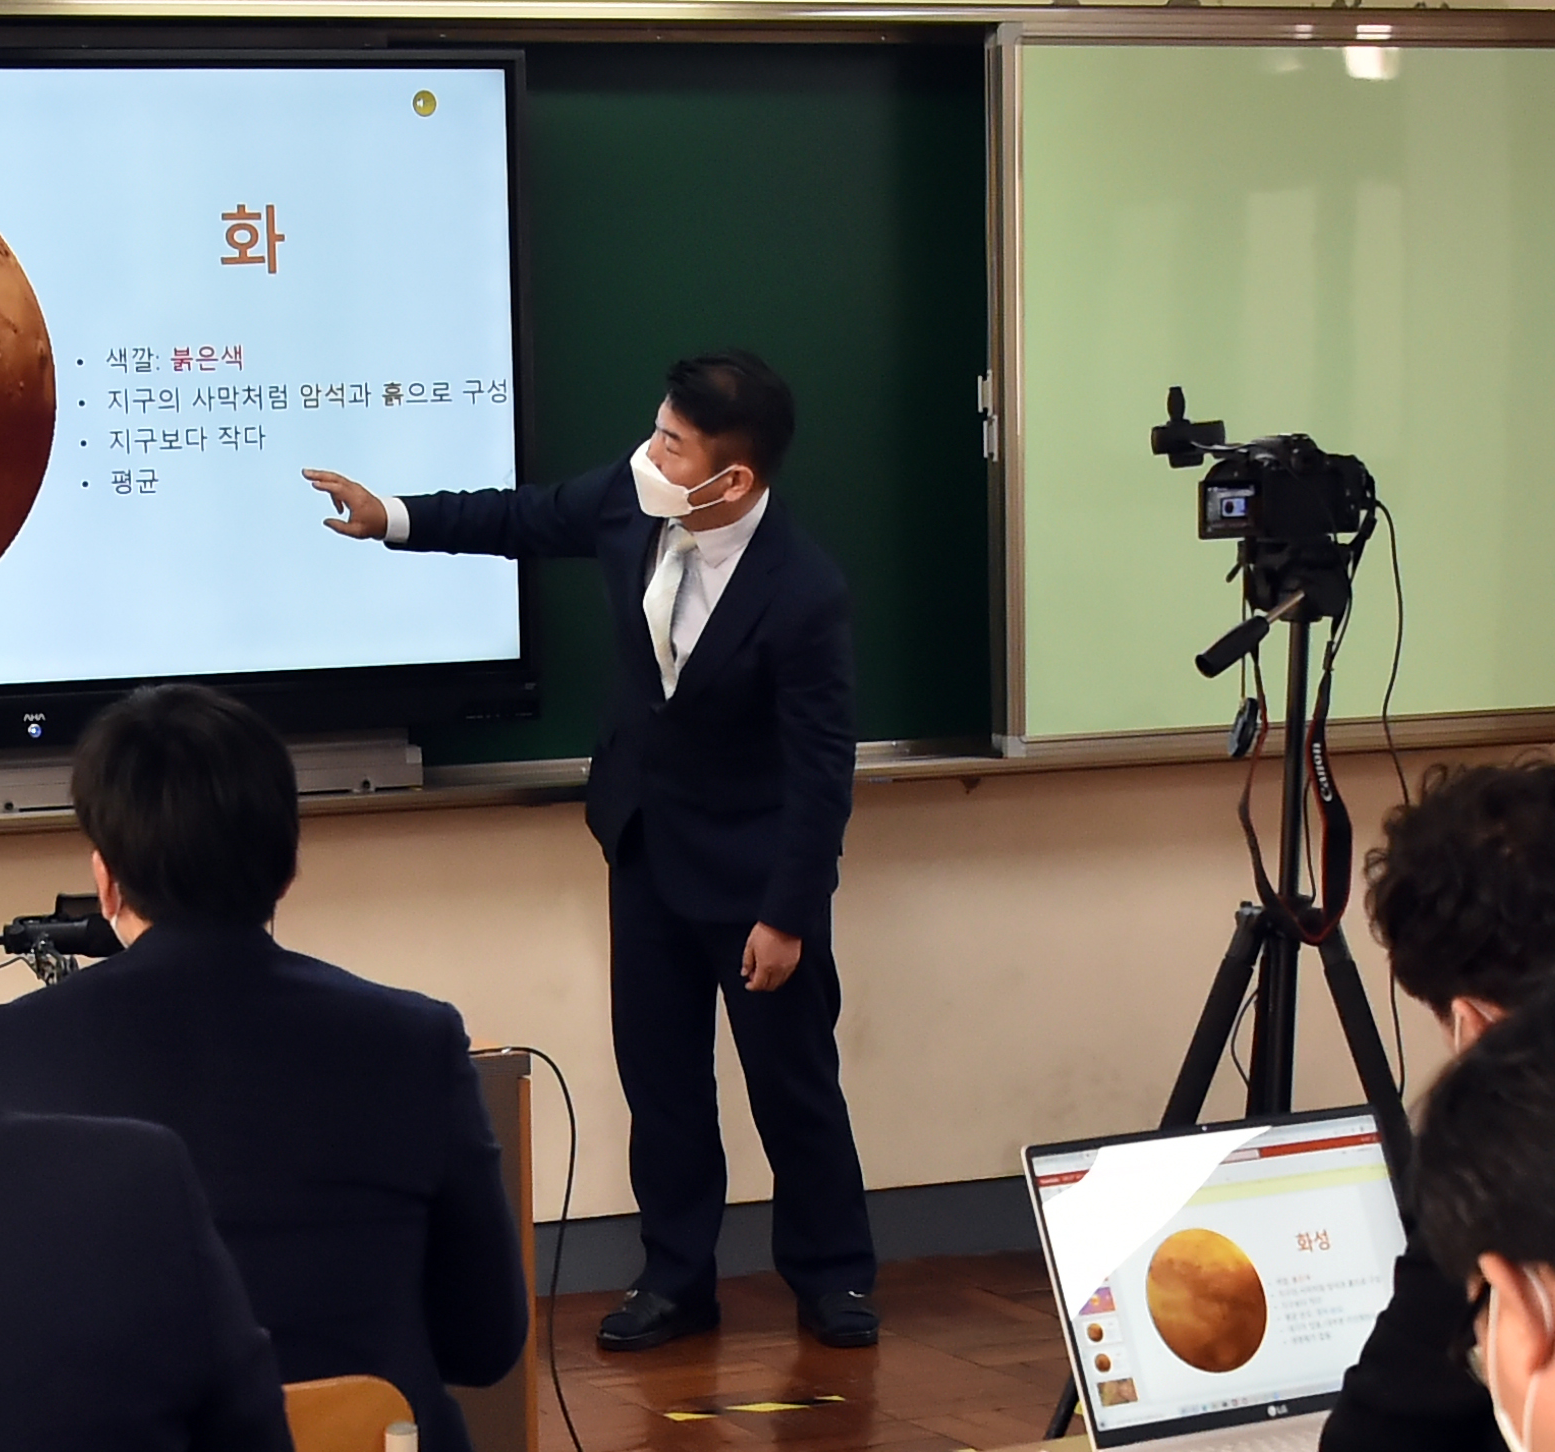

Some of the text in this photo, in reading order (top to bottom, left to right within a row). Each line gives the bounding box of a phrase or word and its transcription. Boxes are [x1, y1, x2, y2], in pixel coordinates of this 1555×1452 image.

[220, 203, 286, 275] 화
[106, 344, 243, 374] 색깔: 붉은색
[108, 378, 507, 415] 지구의 사막처럼 암석과 흙으로 구성
[109, 424, 266, 455] 지구보다 작다
[111, 468, 159, 495] 평균
[1312, 742, 1333, 802] Canon
[1295, 1229, 1332, 1253] 화성
